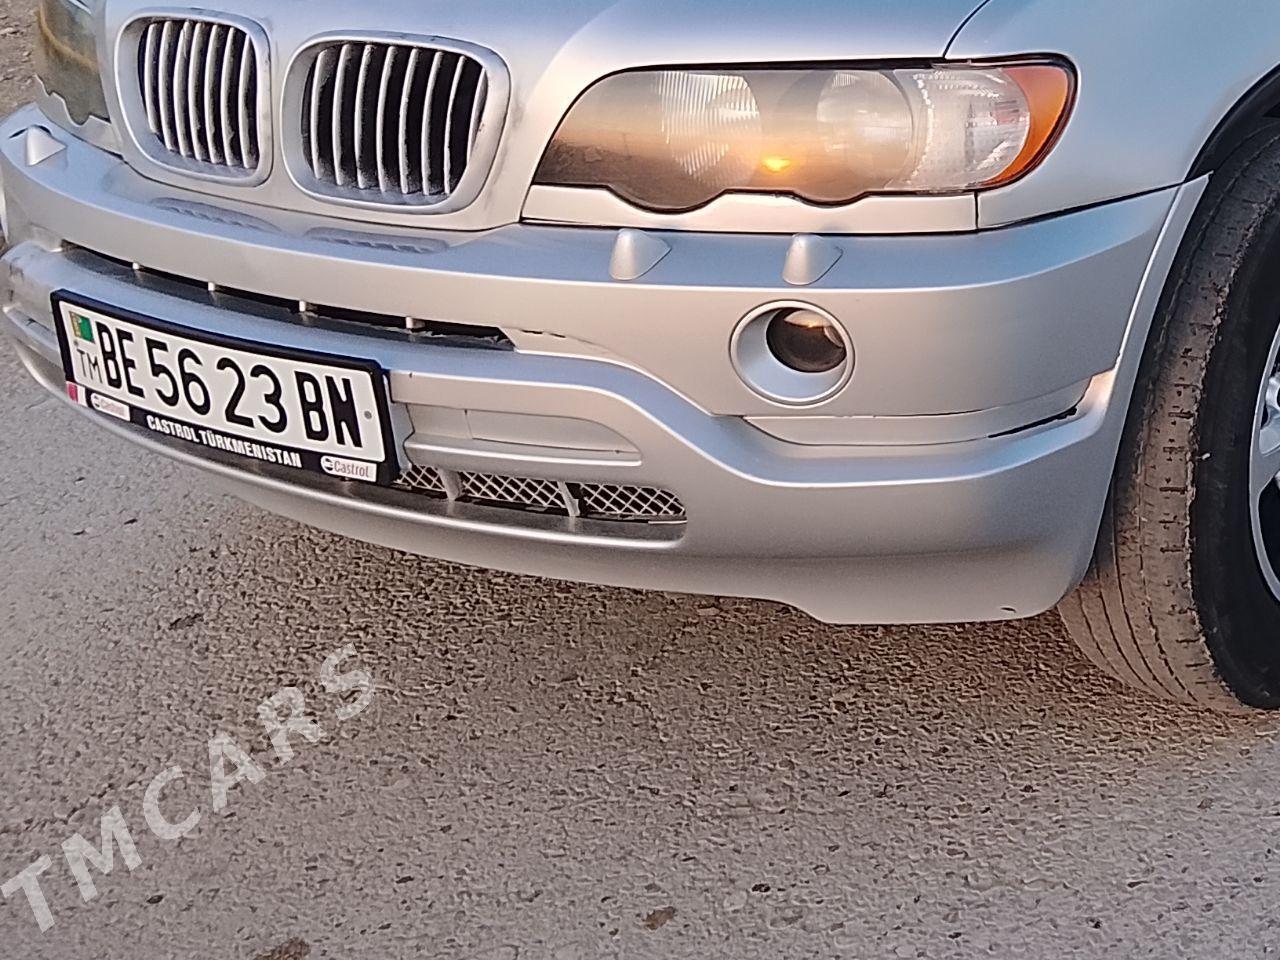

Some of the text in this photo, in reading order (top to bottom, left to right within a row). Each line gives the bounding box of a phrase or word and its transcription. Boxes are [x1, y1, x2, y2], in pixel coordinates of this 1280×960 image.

[76, 348, 103, 384] TM
[146, 414, 200, 443] CASTROL
[334, 460, 369, 478] Castrol
